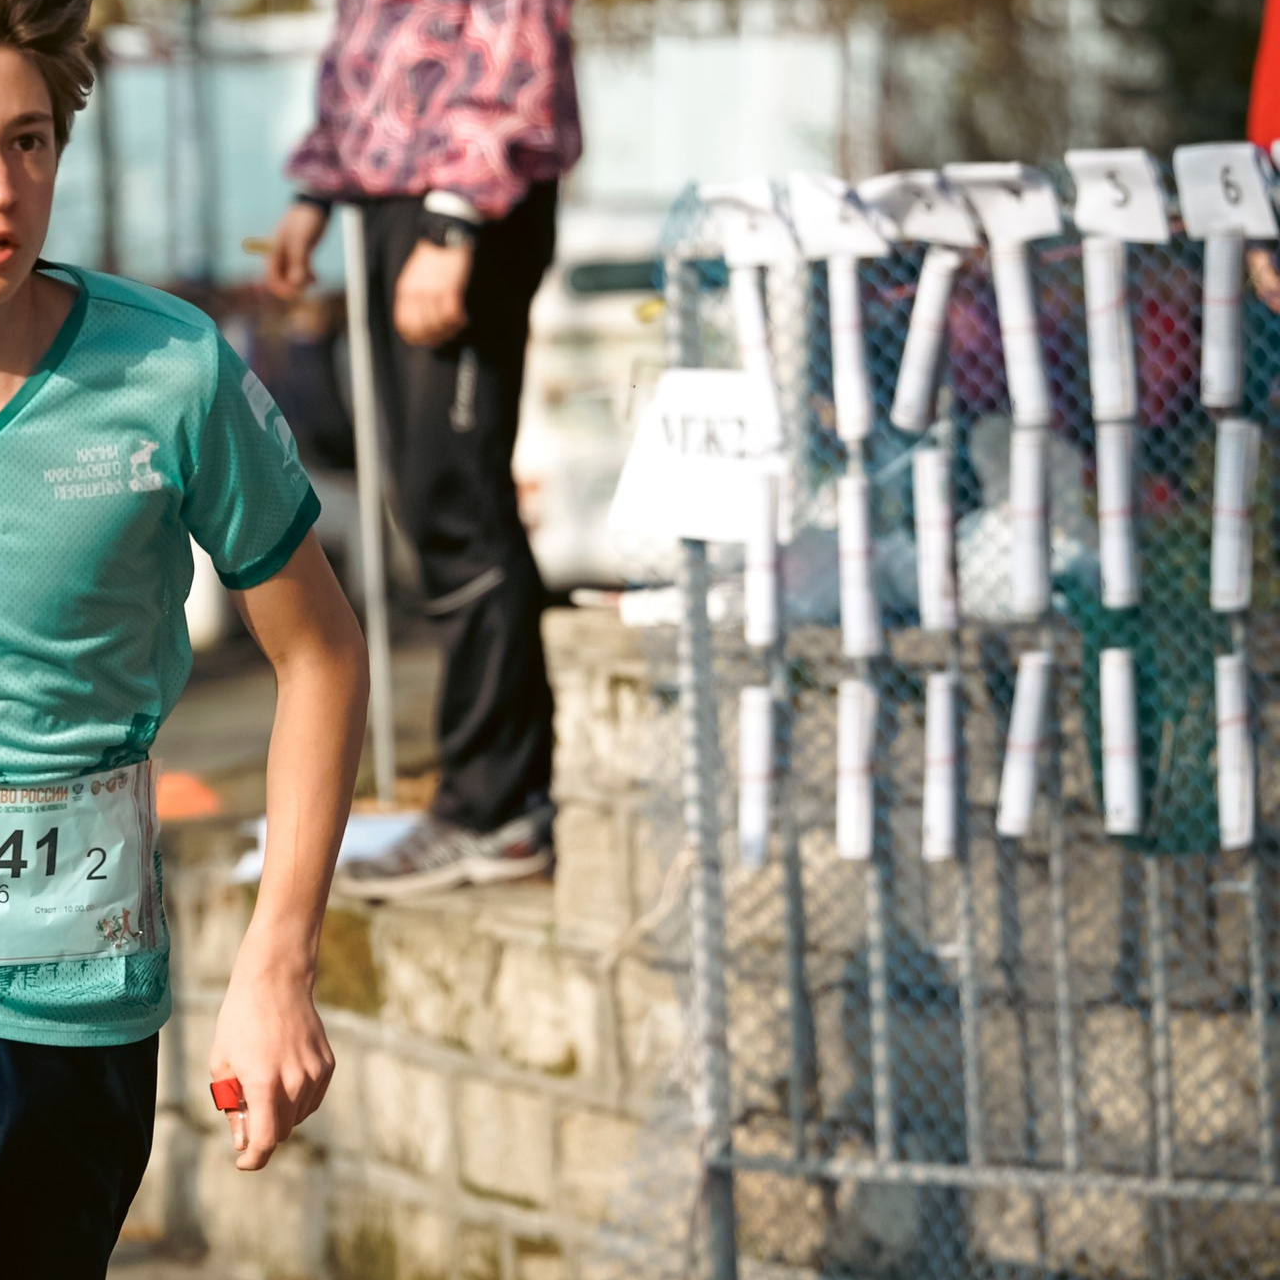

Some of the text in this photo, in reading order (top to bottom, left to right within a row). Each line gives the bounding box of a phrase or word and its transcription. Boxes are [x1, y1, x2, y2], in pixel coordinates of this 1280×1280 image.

[1222, 165, 1241, 205] 6
[20, 785, 68, 804] РОССИИ
[86, 847, 108, 881] 2
